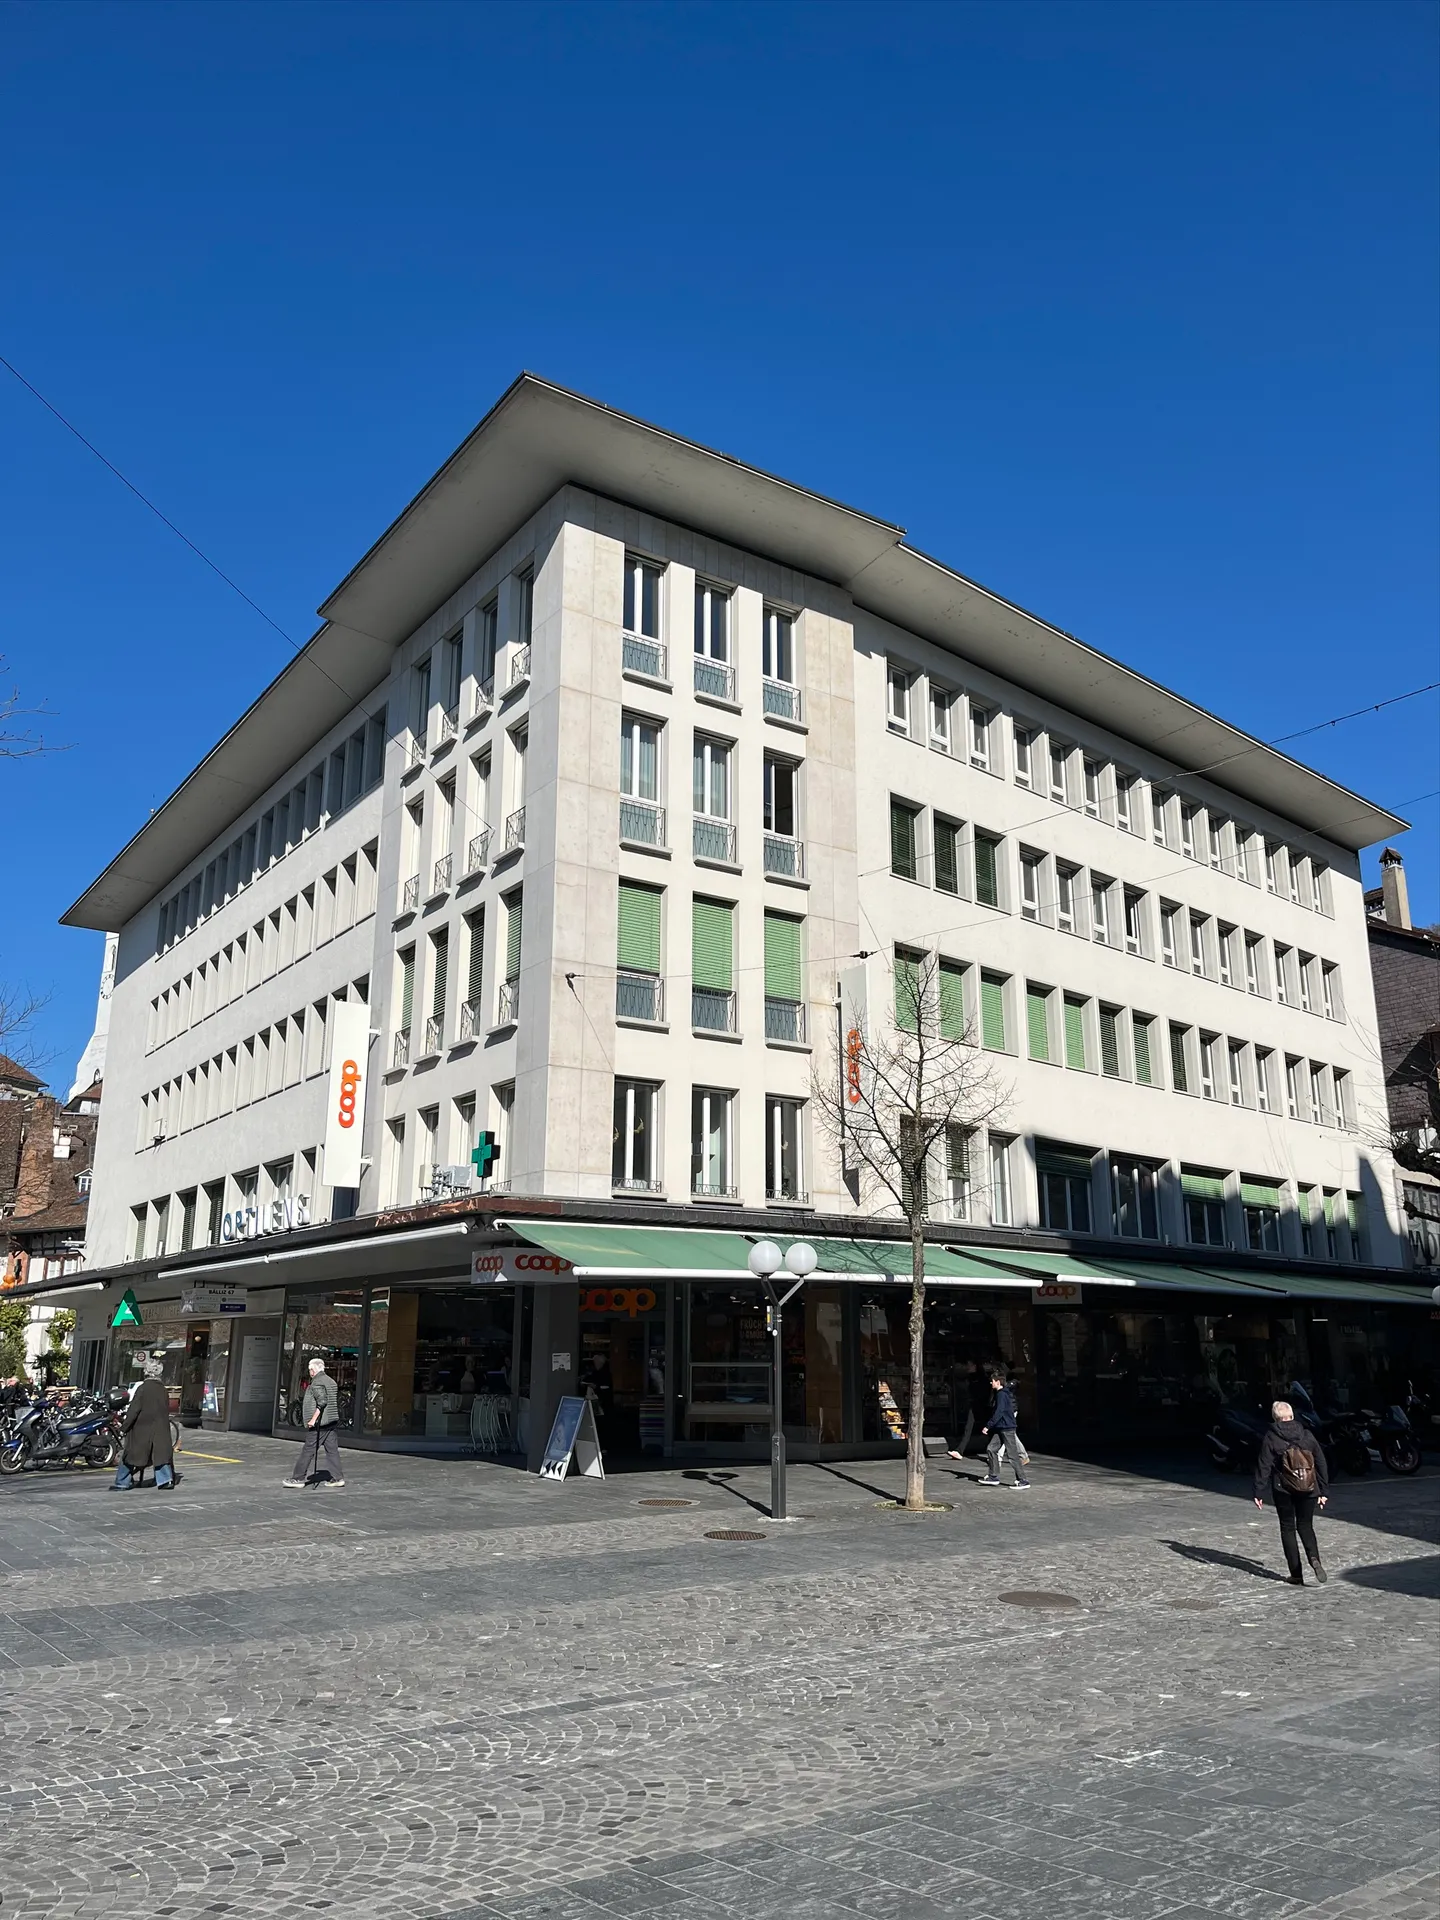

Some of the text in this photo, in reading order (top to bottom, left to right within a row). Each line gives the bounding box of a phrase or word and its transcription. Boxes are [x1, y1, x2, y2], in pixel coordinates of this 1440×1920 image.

[338, 1060, 361, 1128] coop
[223, 1194, 311, 1241] OPTILENS
[475, 1254, 504, 1275] coop
[514, 1254, 571, 1275] coop
[1037, 1284, 1076, 1300] coop
